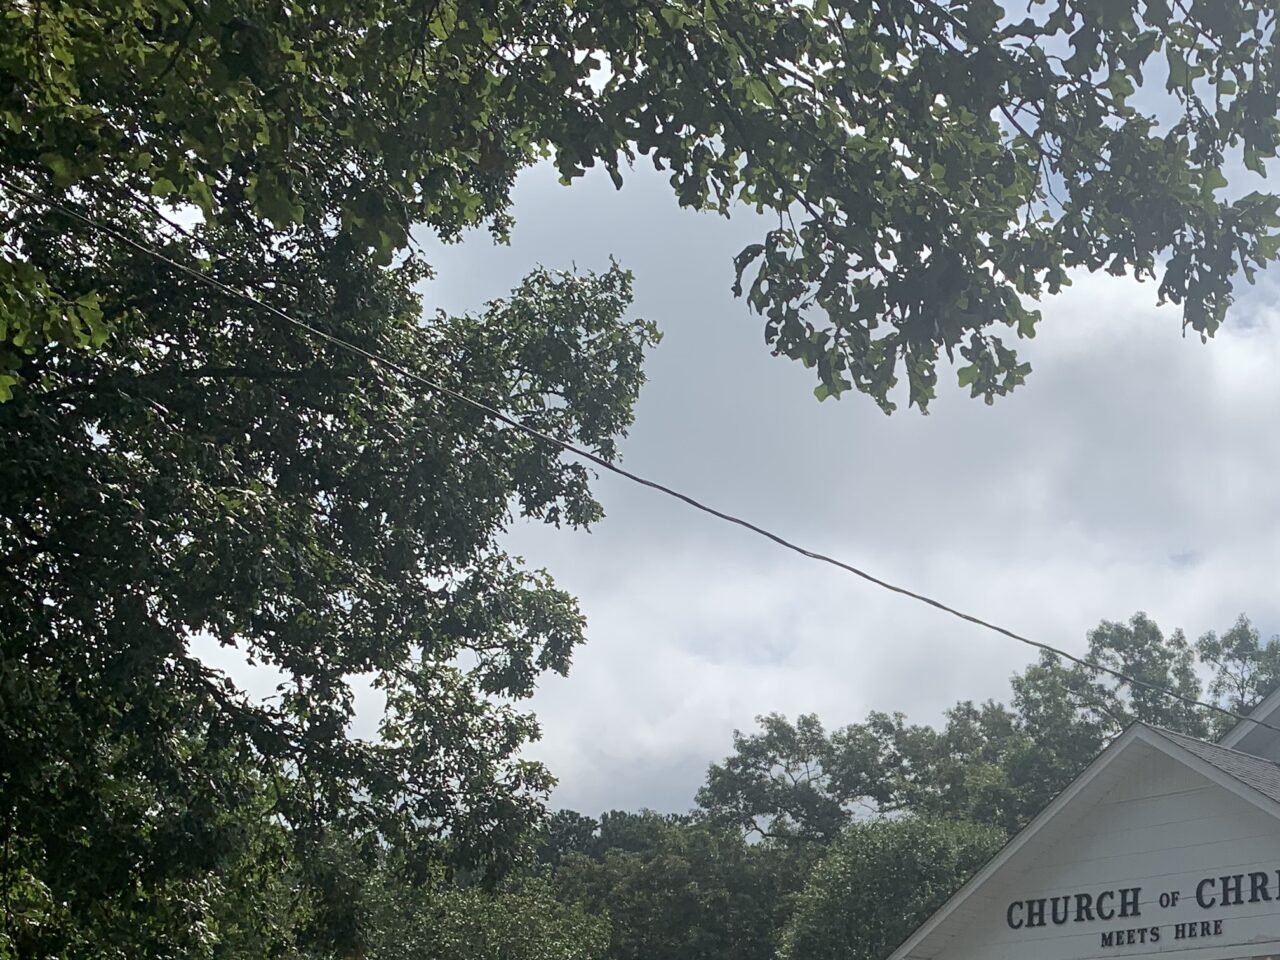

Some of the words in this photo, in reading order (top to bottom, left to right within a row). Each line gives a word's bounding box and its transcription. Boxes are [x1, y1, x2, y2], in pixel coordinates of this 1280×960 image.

[1006, 887, 1142, 930] CHURCH
[1159, 891, 1180, 909] OF
[1101, 926, 1160, 948] MEETS
[1174, 919, 1223, 940] HERE
